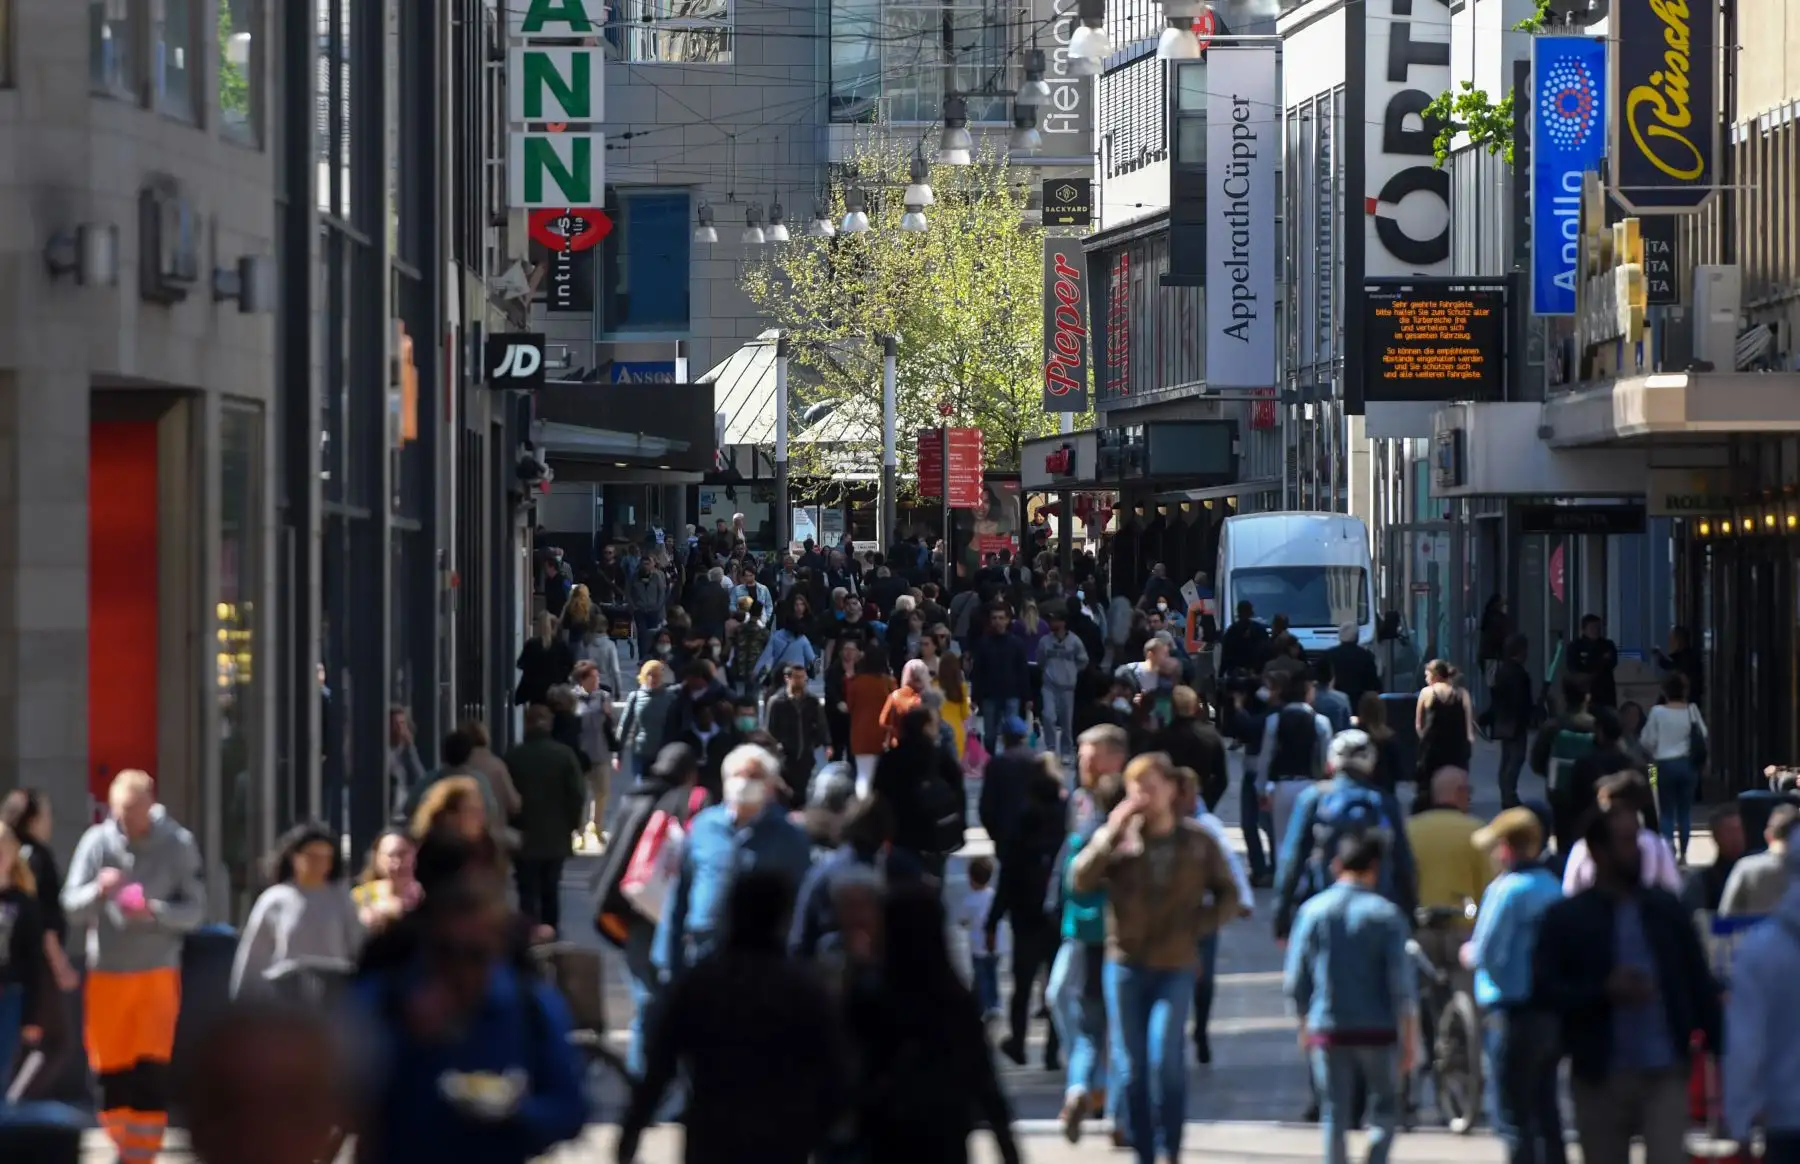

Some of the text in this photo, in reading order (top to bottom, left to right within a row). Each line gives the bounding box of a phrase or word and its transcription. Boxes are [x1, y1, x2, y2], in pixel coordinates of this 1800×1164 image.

[1223, 94, 1257, 344] AppelrathCüpper
[493, 344, 541, 378] JD
[1045, 252, 1086, 396] Pieper
